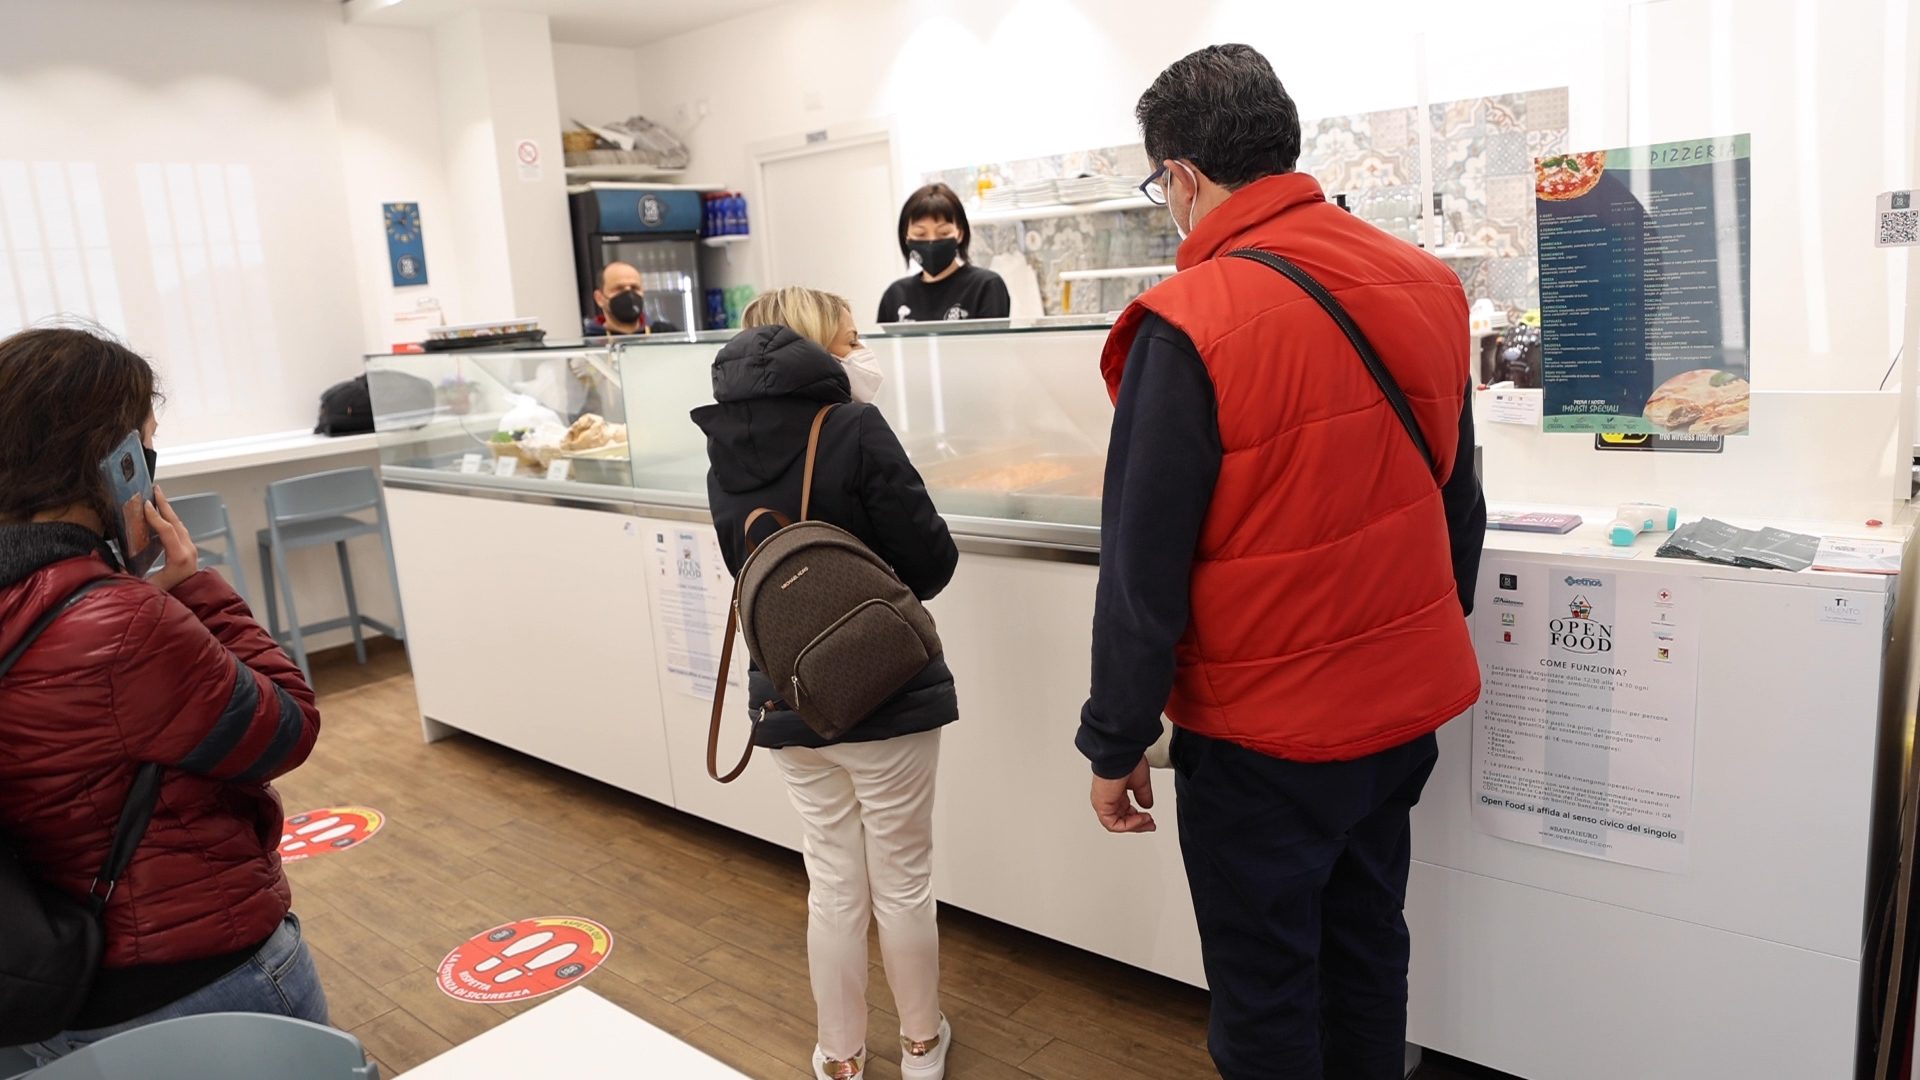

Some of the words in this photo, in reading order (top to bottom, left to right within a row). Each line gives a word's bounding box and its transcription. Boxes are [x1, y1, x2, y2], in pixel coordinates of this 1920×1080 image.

[781, 574, 799, 589] MICHAEL
[797, 566, 809, 576] KORS
[1824, 606, 1860, 615] TALENTO
[1550, 619, 1612, 638] OPEN
[1551, 632, 1612, 652] FOOD
[1540, 659, 1567, 669] COME
[1571, 663, 1627, 676] FUNZIONA?
[1541, 687, 1580, 696] prenotazioni
[1568, 680, 1597, 689] simbolico
[1495, 692, 1525, 700] consentito
[1495, 702, 1526, 710] consentito
[1515, 730, 1542, 739] simbolico
[1559, 727, 1592, 736] sostenitori
[1605, 735, 1633, 743] progetto
[1491, 751, 1524, 761] Condimenti
[1498, 762, 1520, 771] pizzeria
[1535, 768, 1553, 777] tavola
[1572, 776, 1606, 786] rimangono
[1608, 783, 1635, 791] operativi
[1657, 792, 1680, 800] sempre
[1518, 777, 1544, 785] progetto
[1572, 785, 1603, 796] donazione
[1504, 783, 1525, 792] tramite
[1534, 788, 1561, 798] Cartolina
[1612, 802, 1653, 815] inquadrando
[1544, 786, 1575, 796] all'interno
[1588, 793, 1606, 801] locale
[1516, 790, 1537, 799] donare
[1578, 801, 1604, 811] bancario
[1612, 807, 1632, 816] PayPal
[1481, 796, 1502, 806] Open
[1505, 800, 1525, 810] Food
[1537, 807, 1560, 817] affida
[1572, 814, 1597, 824] senso
[1599, 818, 1624, 829] civico
[1627, 824, 1640, 832] del
[1643, 826, 1677, 839] singolo
[561, 920, 593, 933] ASPETTA
[447, 954, 462, 965] LA
[441, 962, 457, 993] DISTANZA
[458, 971, 491, 991] RISPETTA
[455, 988, 466, 998] DI
[465, 988, 530, 1000] SICUREZZA
